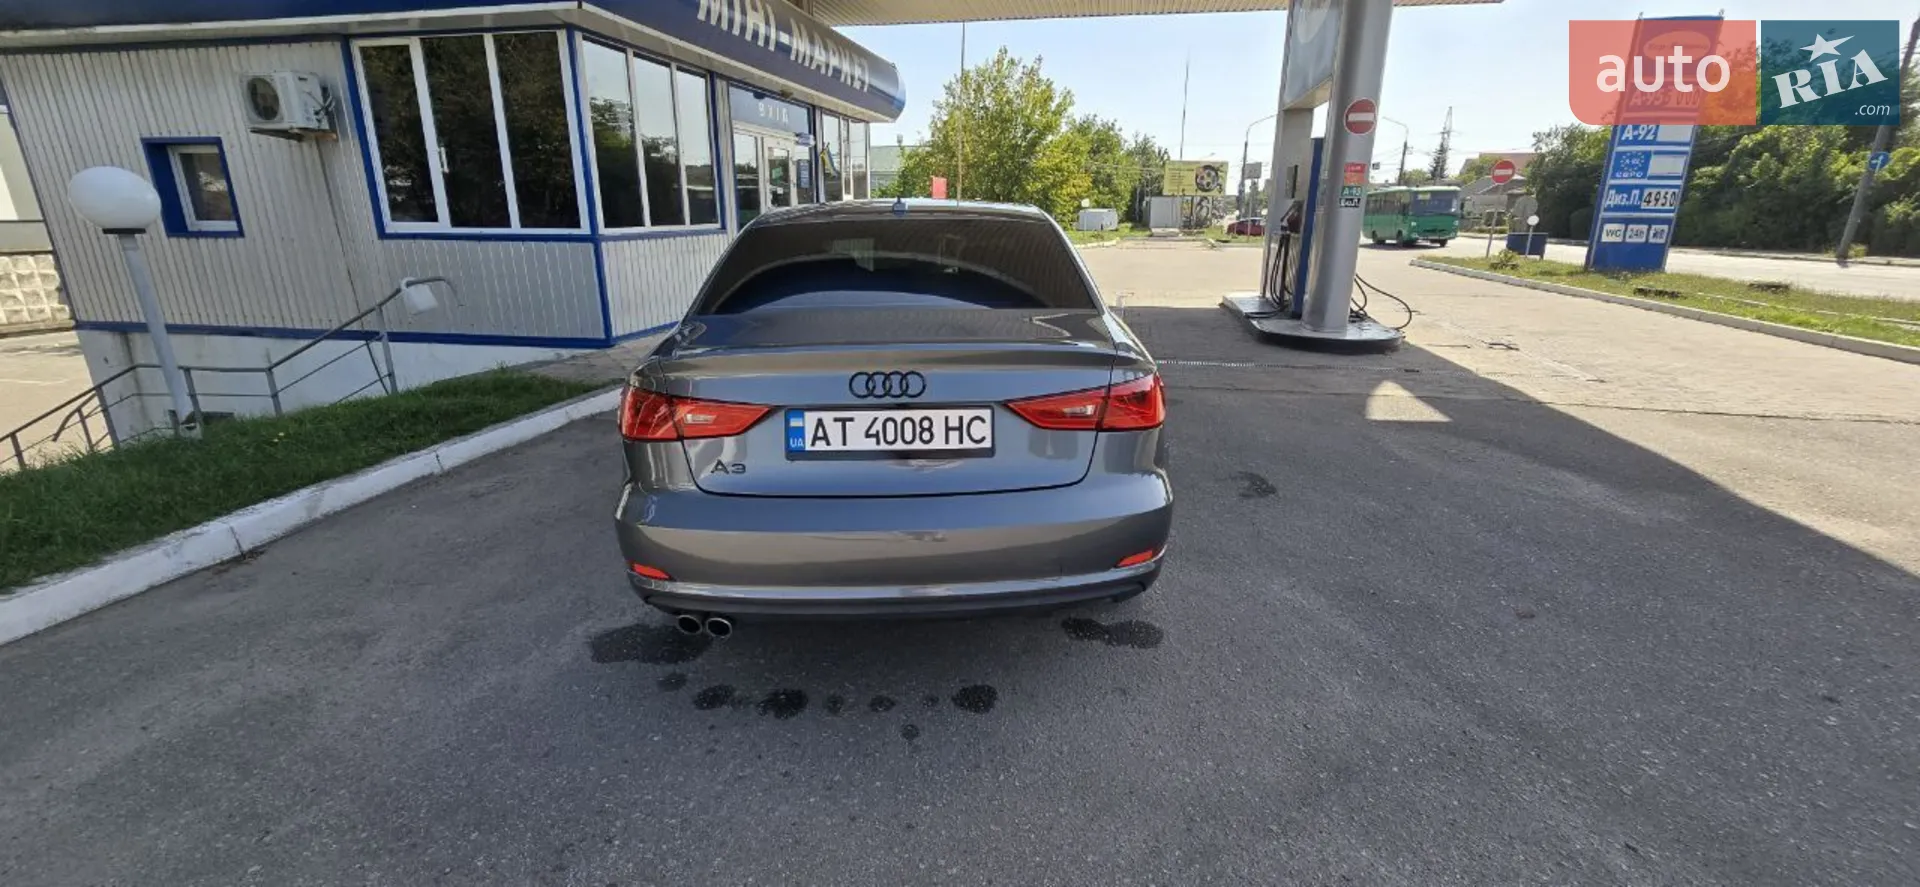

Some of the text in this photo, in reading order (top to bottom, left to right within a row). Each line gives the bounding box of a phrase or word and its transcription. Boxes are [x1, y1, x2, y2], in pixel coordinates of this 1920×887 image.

[1643, 190, 1677, 207] 4950
[1605, 229, 1621, 238] WC
[810, 415, 987, 447] AT 4008 HC
[790, 438, 804, 448] UA
[710, 459, 746, 475] A3
